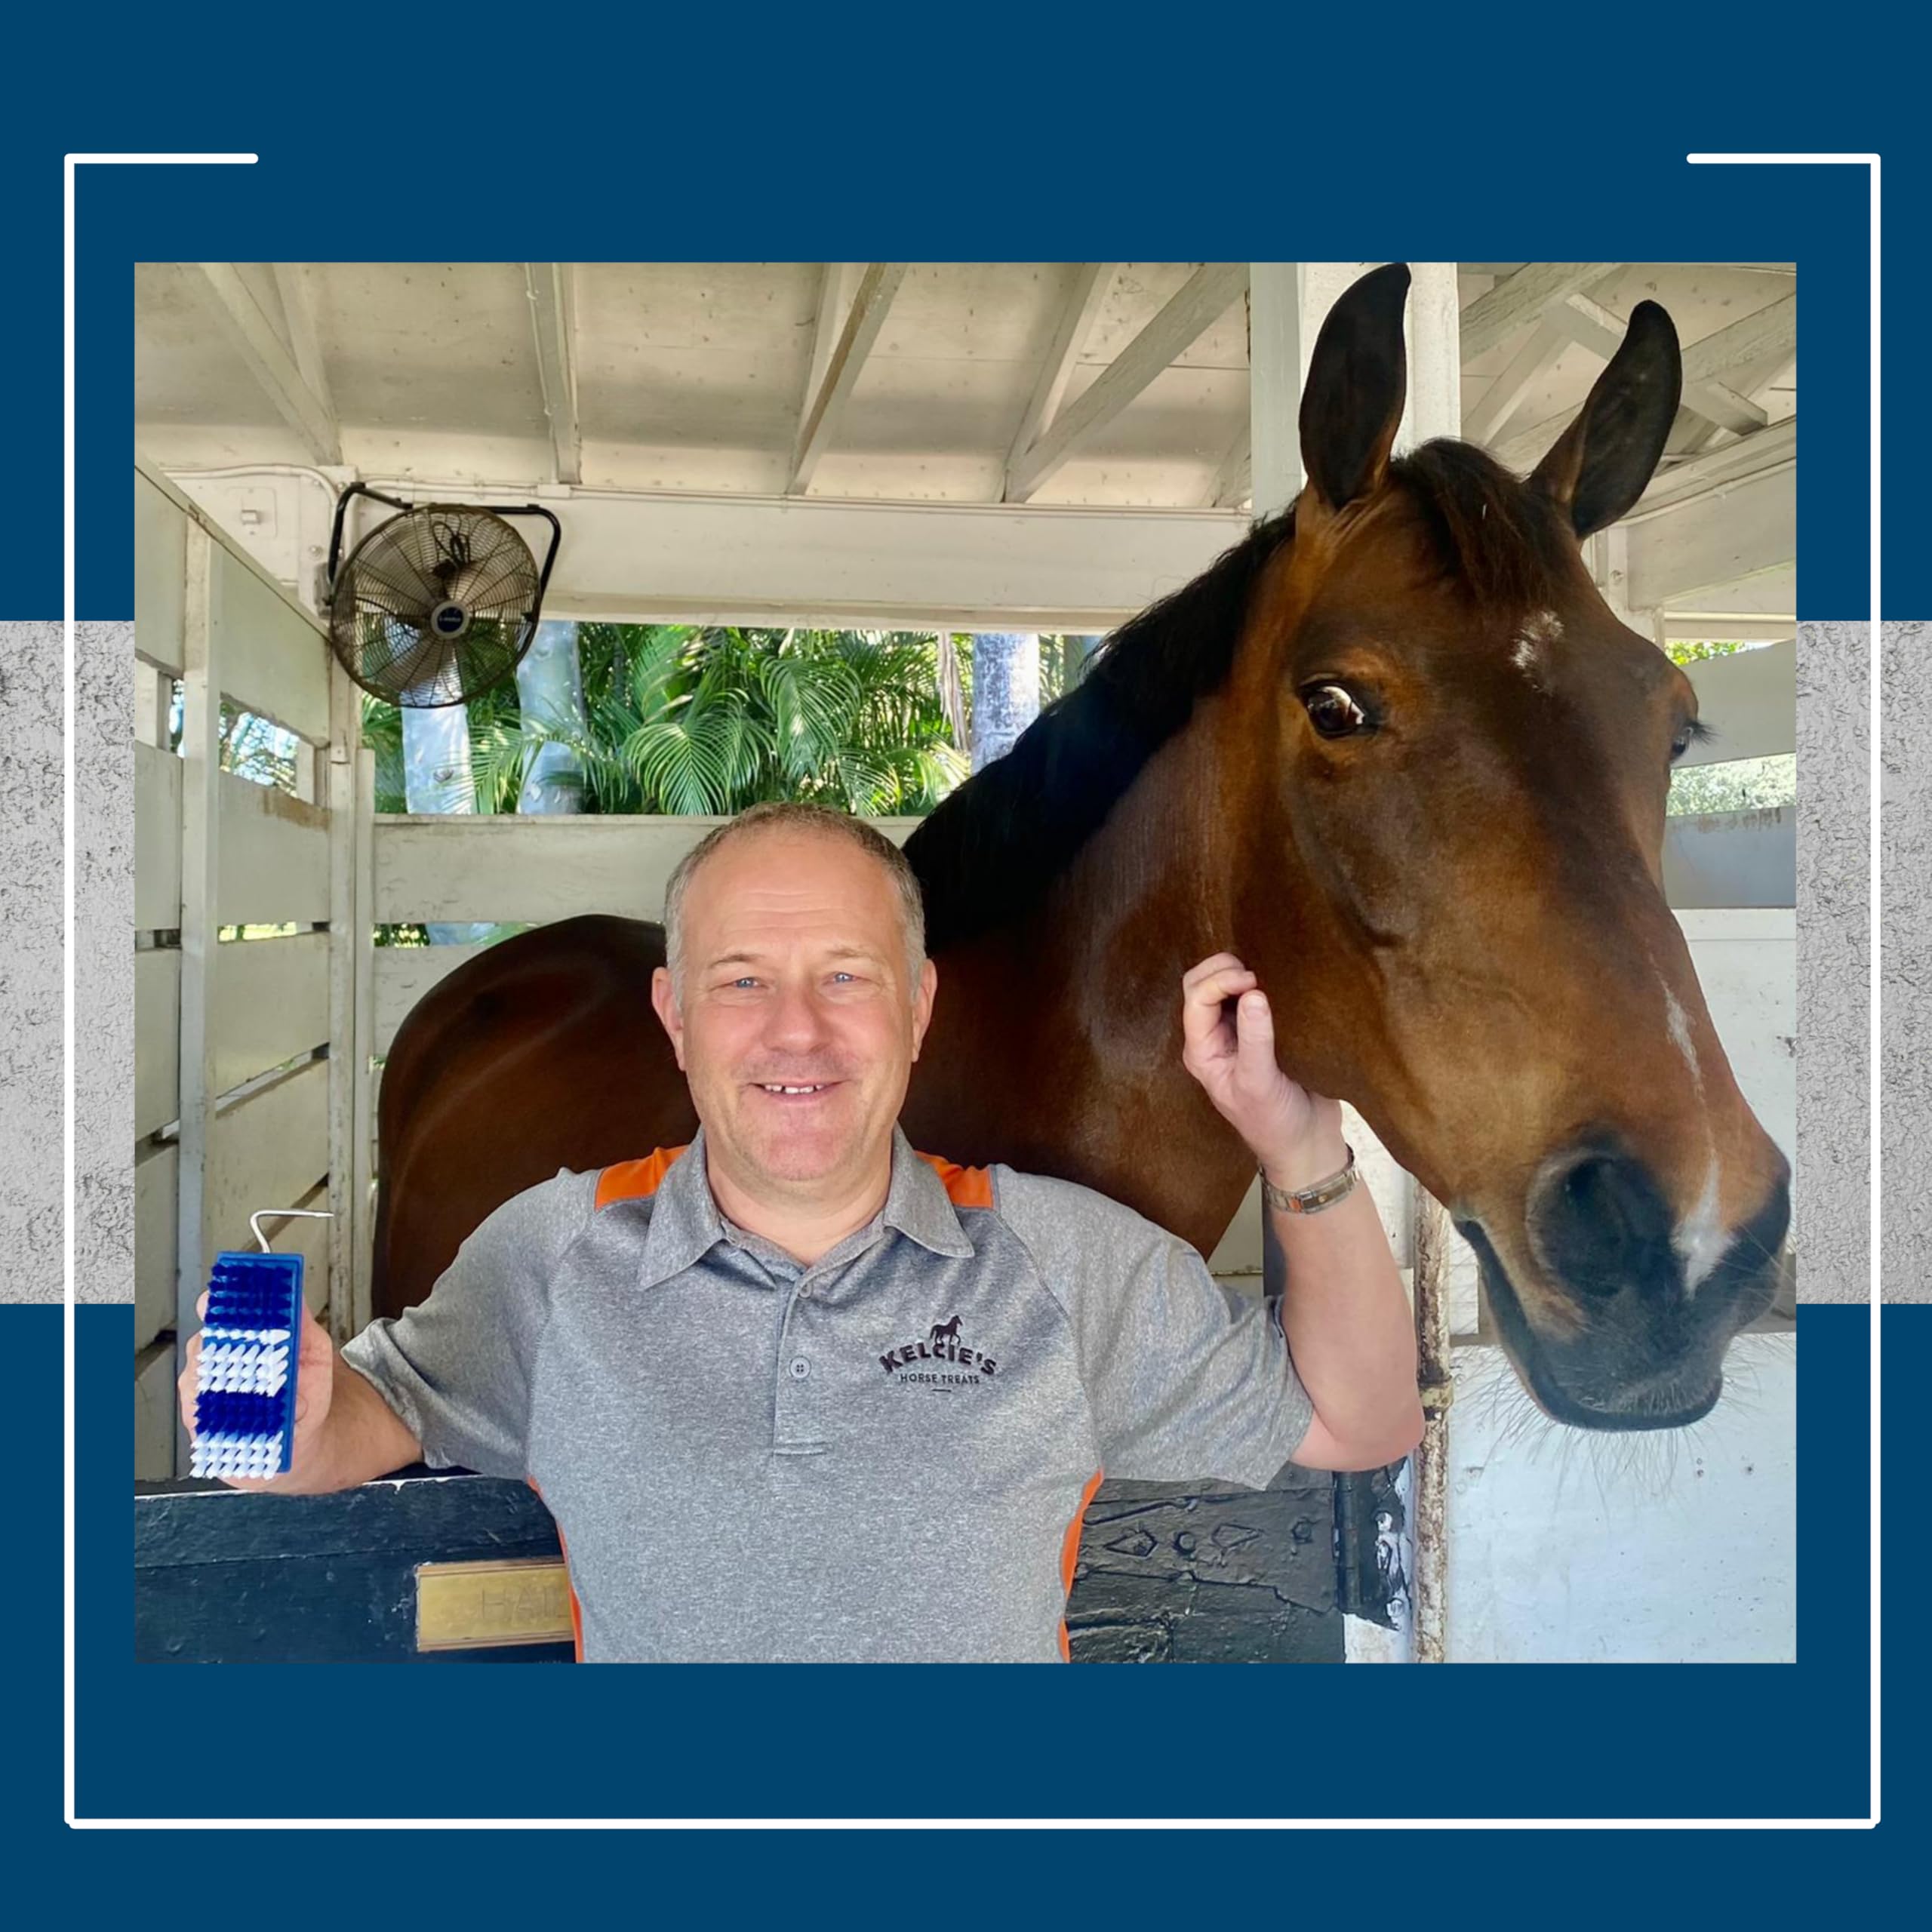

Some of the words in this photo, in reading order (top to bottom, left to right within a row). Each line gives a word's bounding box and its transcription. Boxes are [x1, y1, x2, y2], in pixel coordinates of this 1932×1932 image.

[878, 1342, 997, 1376] KELCIE'S
[900, 1374, 938, 1384] HORSE
[941, 1374, 980, 1385] TREATS
